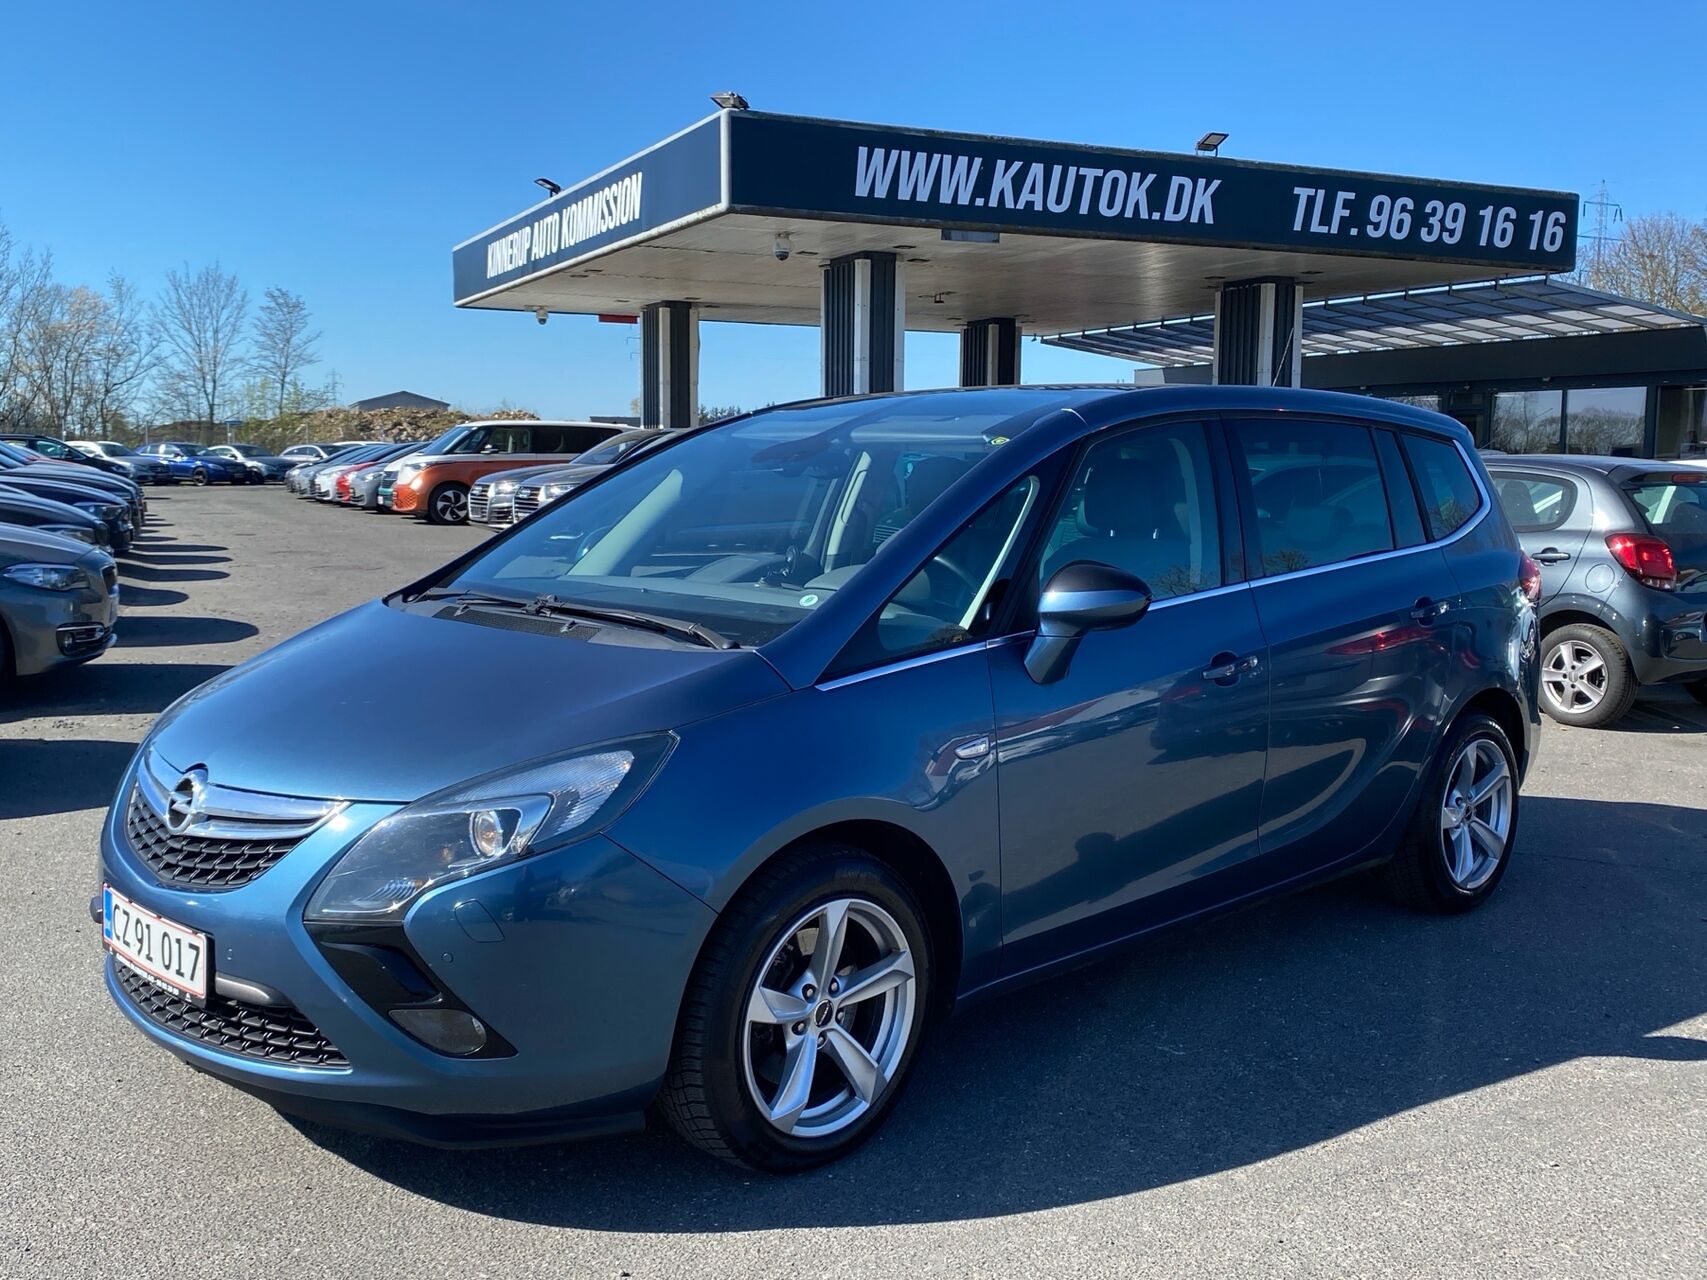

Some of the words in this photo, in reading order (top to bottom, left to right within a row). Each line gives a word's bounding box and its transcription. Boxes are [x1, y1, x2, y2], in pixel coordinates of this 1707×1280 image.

[487, 226, 531, 279] KINNERUP
[531, 212, 560, 261] AUTO
[561, 171, 643, 250] KOMMISSION
[855, 146, 1222, 225] WWW.KAUTOK.DK
[1293, 186, 1359, 236] TLF.
[1366, 194, 1414, 240] 96
[1420, 200, 1467, 245] 39
[1479, 205, 1517, 249] 16
[1529, 210, 1567, 253] 16
[113, 903, 131, 949] CZ
[135, 917, 153, 963] 91
[161, 931, 200, 982] 017
